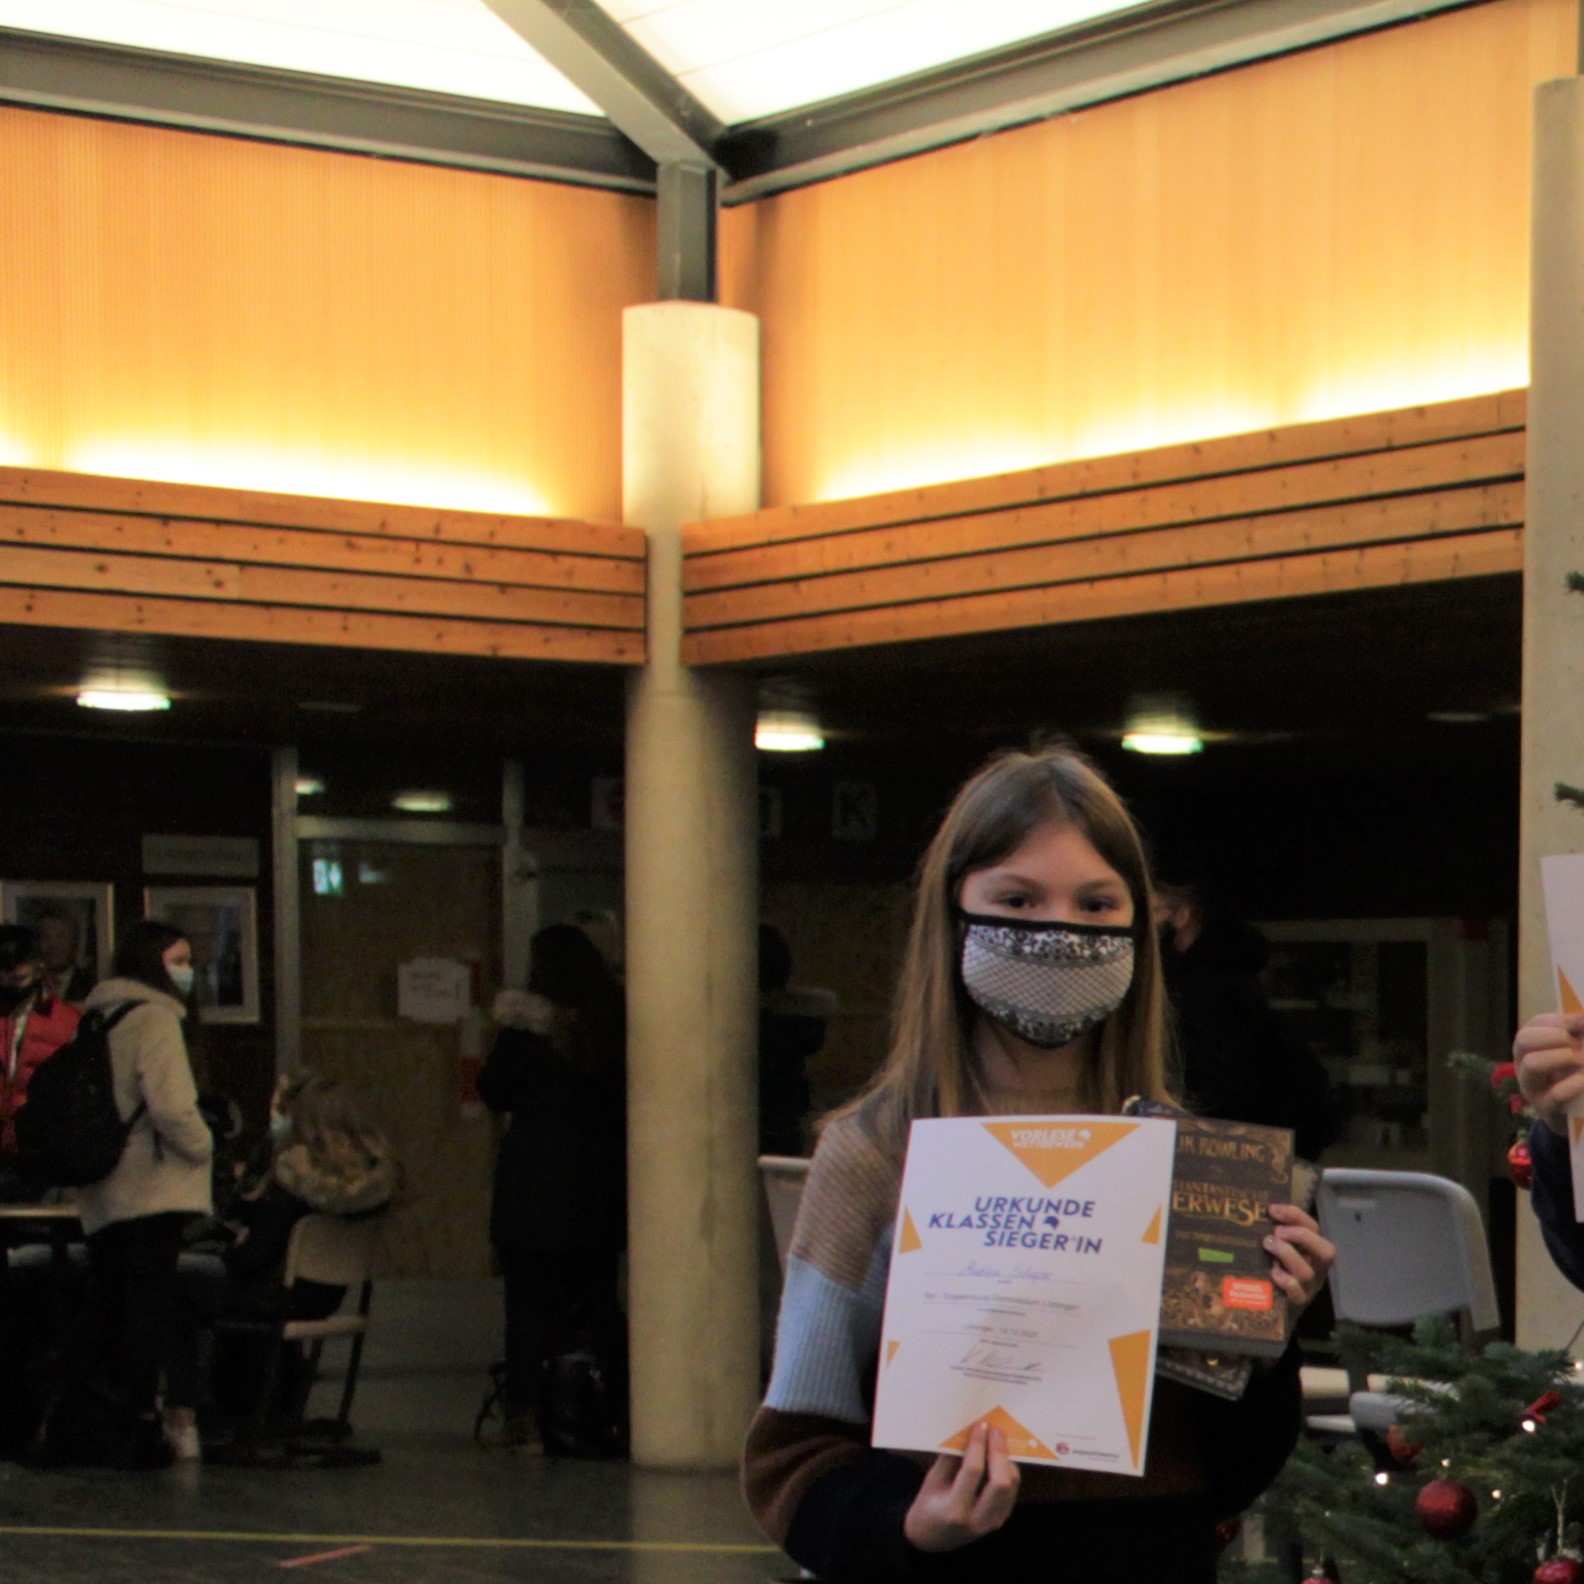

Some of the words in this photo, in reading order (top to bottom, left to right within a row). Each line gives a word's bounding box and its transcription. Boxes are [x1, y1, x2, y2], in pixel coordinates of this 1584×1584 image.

[1010, 1128, 1077, 1141] VORLESE
[975, 1196, 1096, 1218] URKUNDE
[1172, 1191, 1270, 1227] ERWESE
[928, 1213, 1036, 1231] KLASSEN
